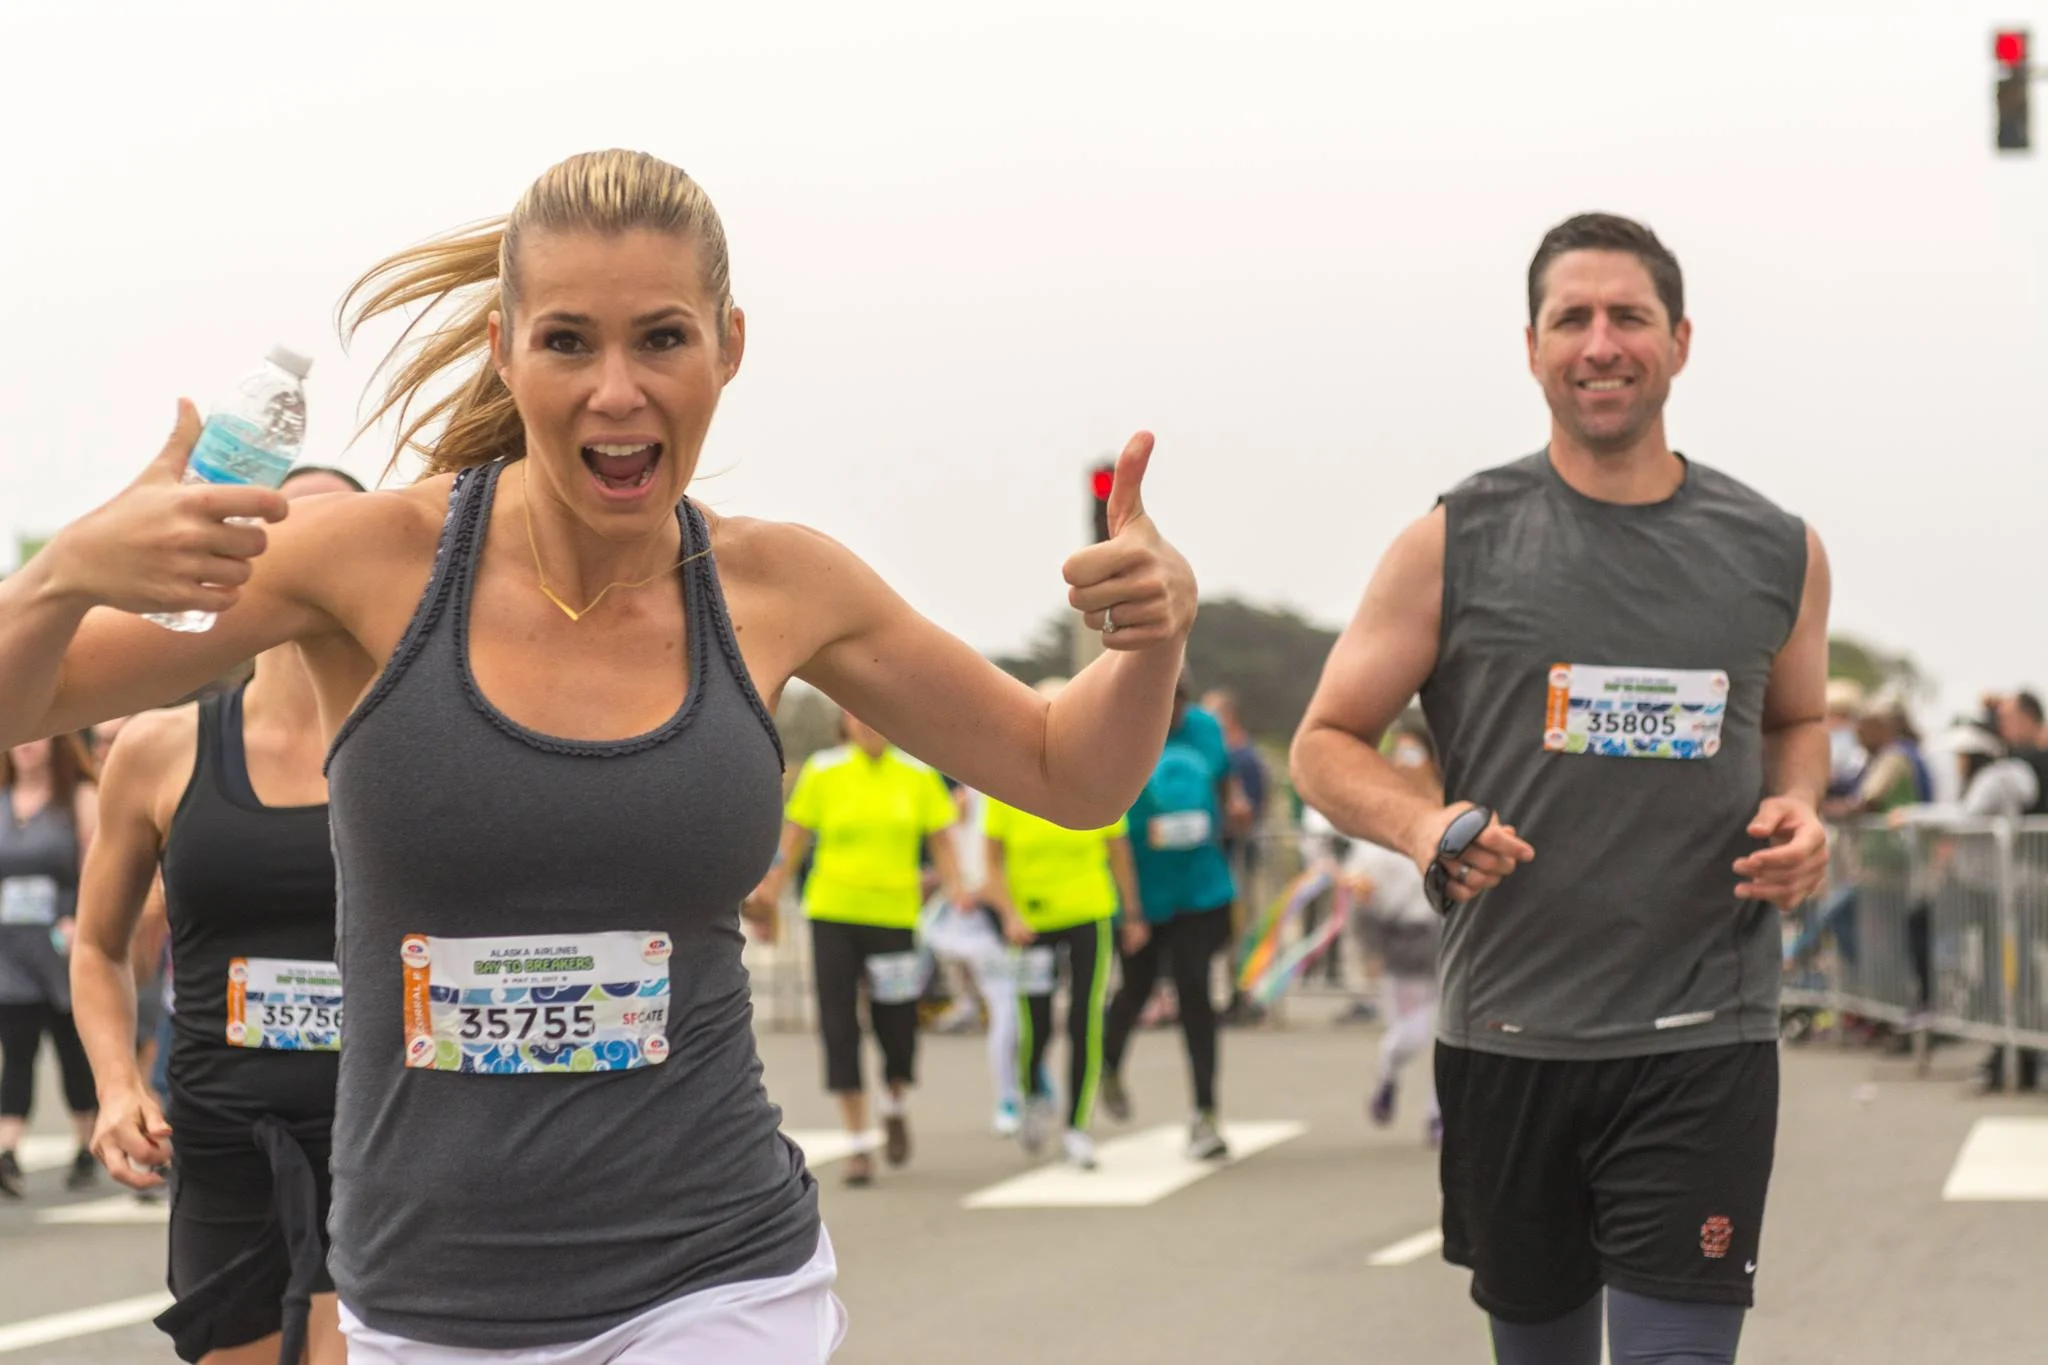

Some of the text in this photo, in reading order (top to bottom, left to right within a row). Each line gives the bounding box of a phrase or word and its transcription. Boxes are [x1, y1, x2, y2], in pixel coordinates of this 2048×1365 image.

[1587, 712, 1676, 735] 35805
[490, 946, 578, 957] ALASKA AIRLINES
[473, 955, 595, 975] BAY TO BREAKERS
[263, 1004, 343, 1028] 35756
[459, 1005, 596, 1040] 35755
